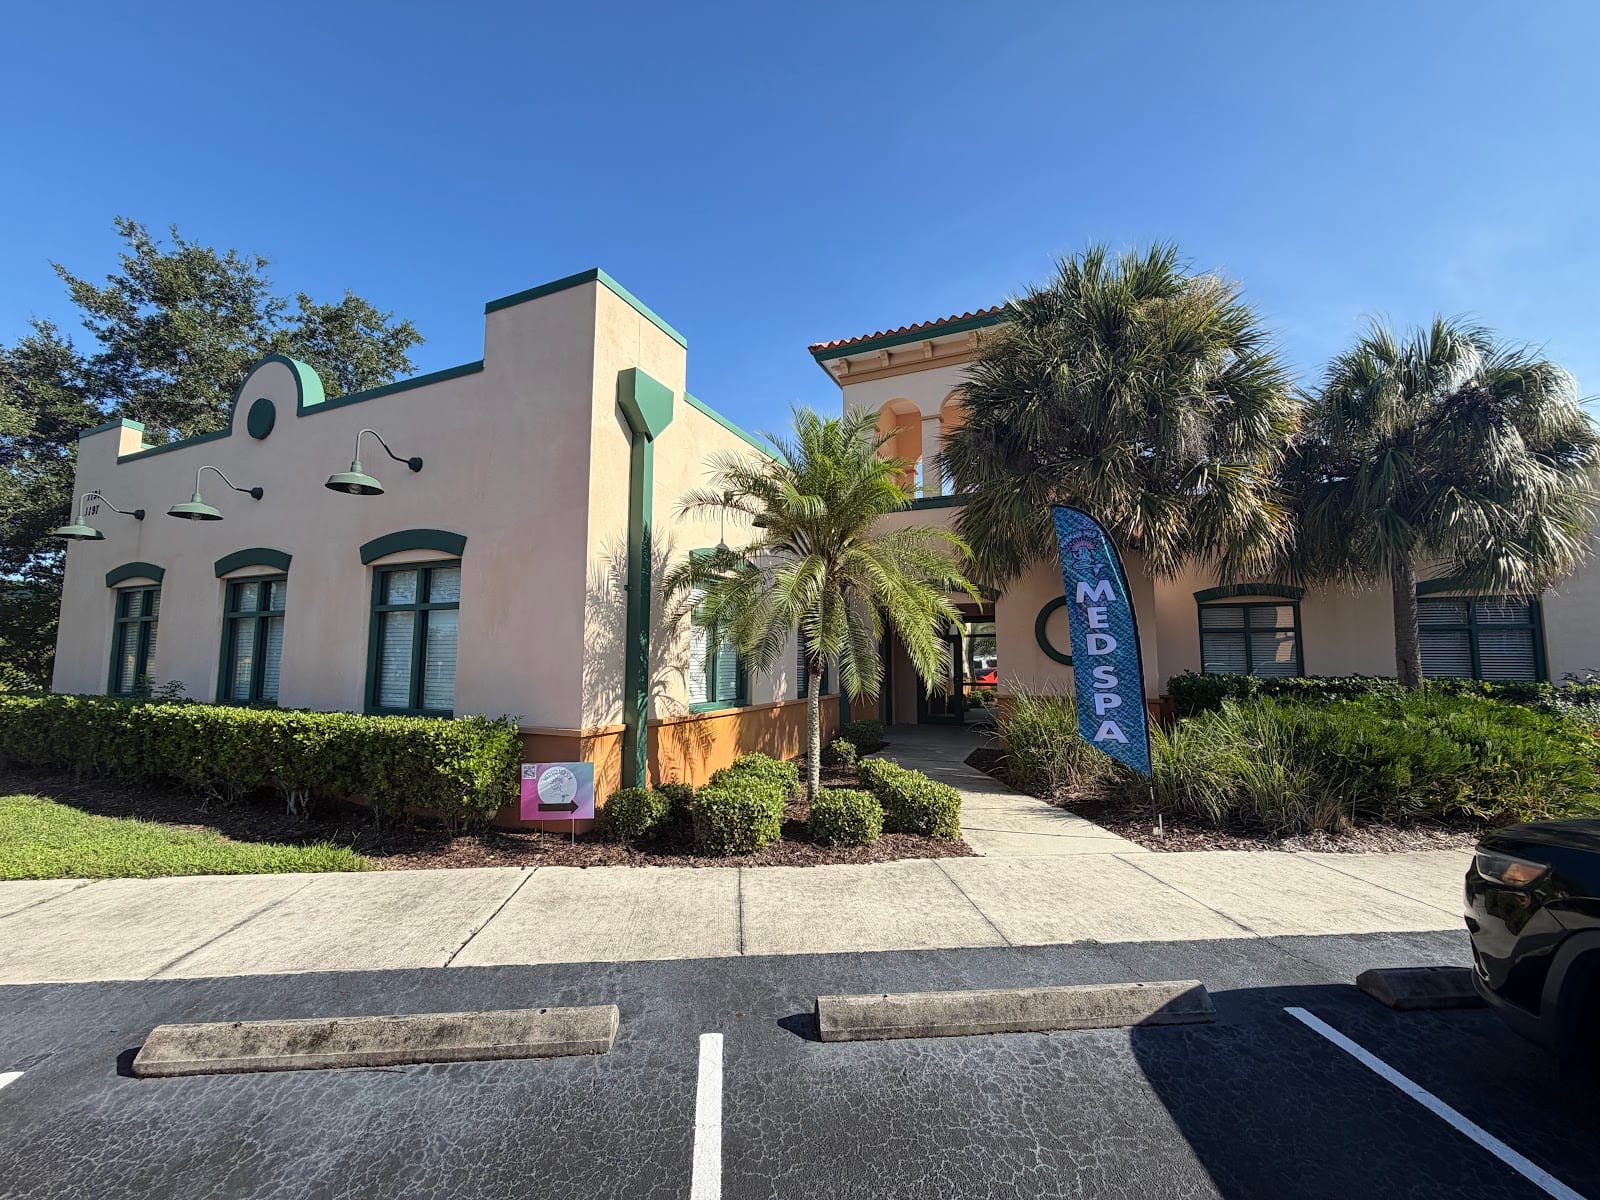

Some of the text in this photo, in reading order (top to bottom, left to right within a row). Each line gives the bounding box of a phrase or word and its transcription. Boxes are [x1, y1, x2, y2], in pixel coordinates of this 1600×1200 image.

[85, 504, 100, 517] 1197
[1075, 579, 1117, 656] MED
[1092, 665, 1129, 744] SPA
